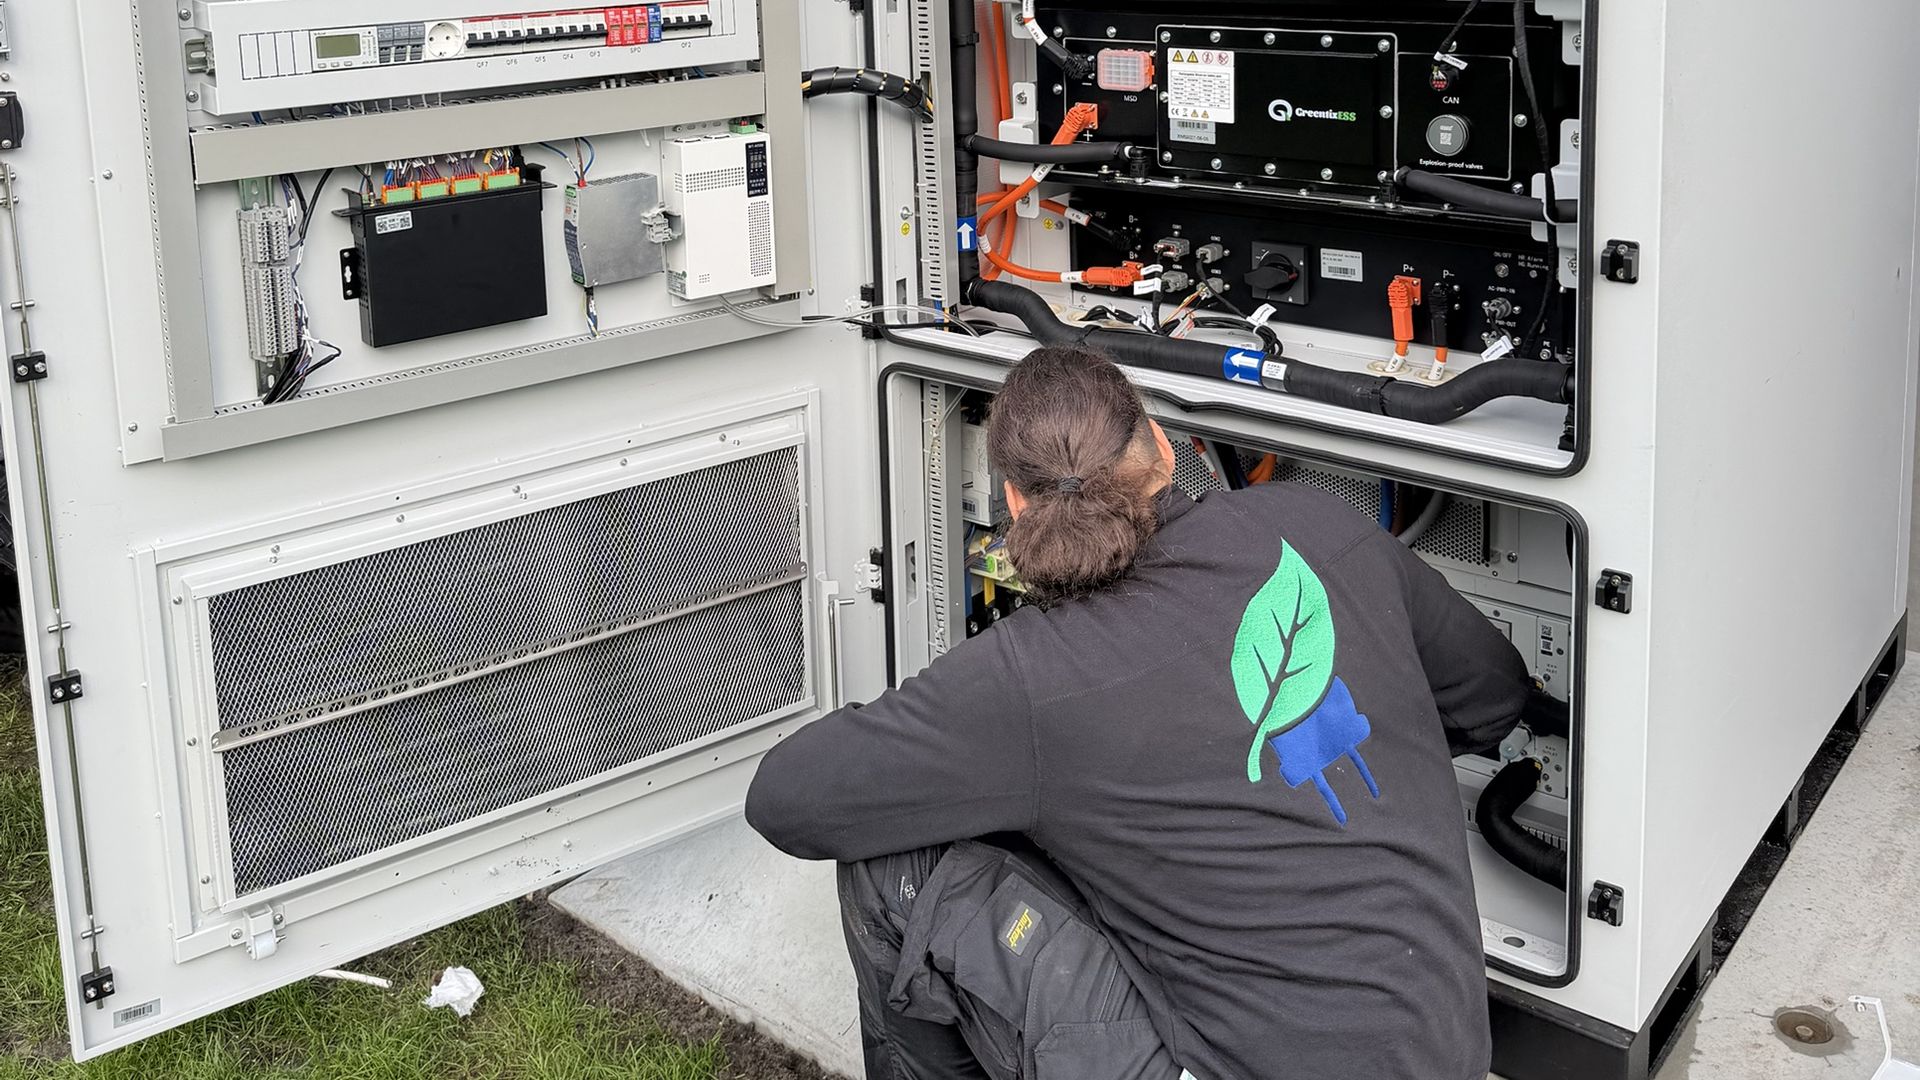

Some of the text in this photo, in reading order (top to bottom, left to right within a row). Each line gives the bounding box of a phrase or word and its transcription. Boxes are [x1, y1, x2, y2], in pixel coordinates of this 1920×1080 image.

[1442, 96, 1460, 104] CAN
[1295, 107, 1356, 121] GreentixESS
[1419, 159, 1484, 170] Explosion-proof valves
[1403, 264, 1414, 272] P+
[1486, 318, 1516, 328] APWR-OUT
